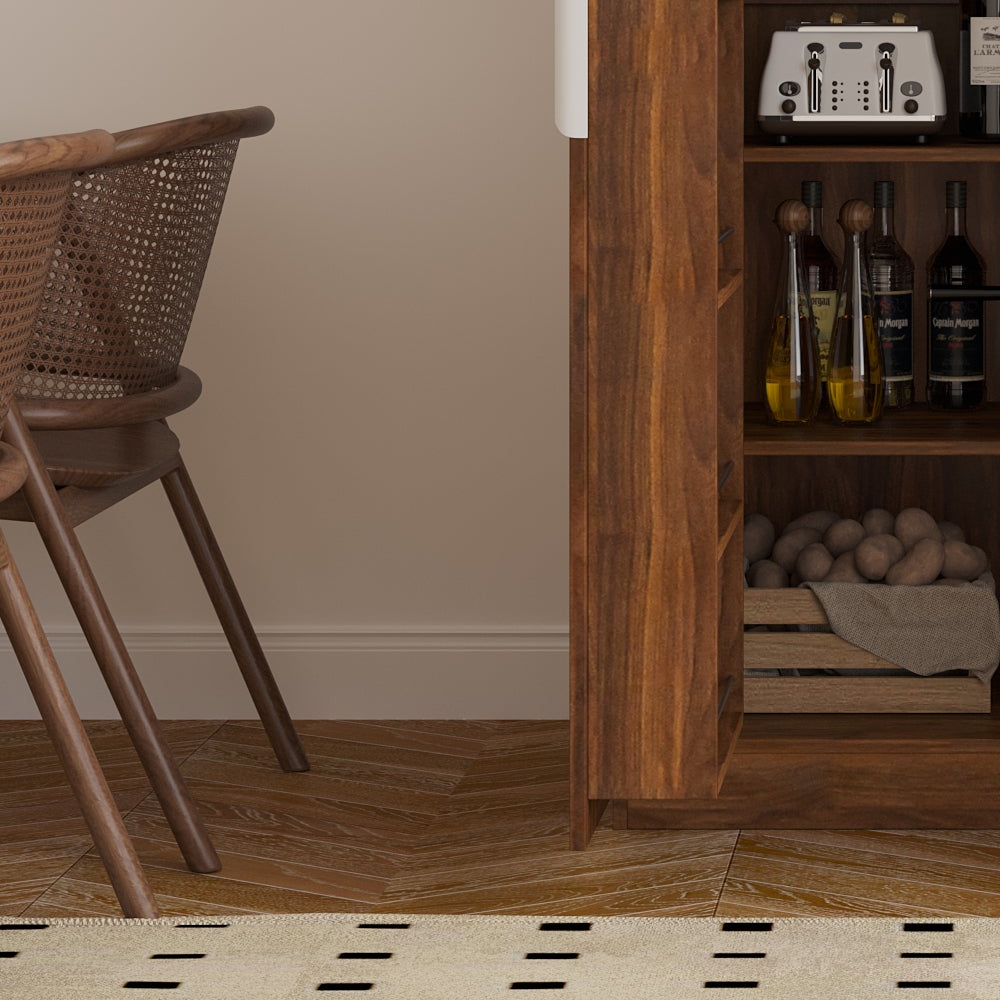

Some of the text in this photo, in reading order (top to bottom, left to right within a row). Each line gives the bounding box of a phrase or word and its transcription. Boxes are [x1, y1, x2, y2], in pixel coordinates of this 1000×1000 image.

[884, 318, 908, 329] Morgan
[932, 317, 980, 330] Captain Morgan
